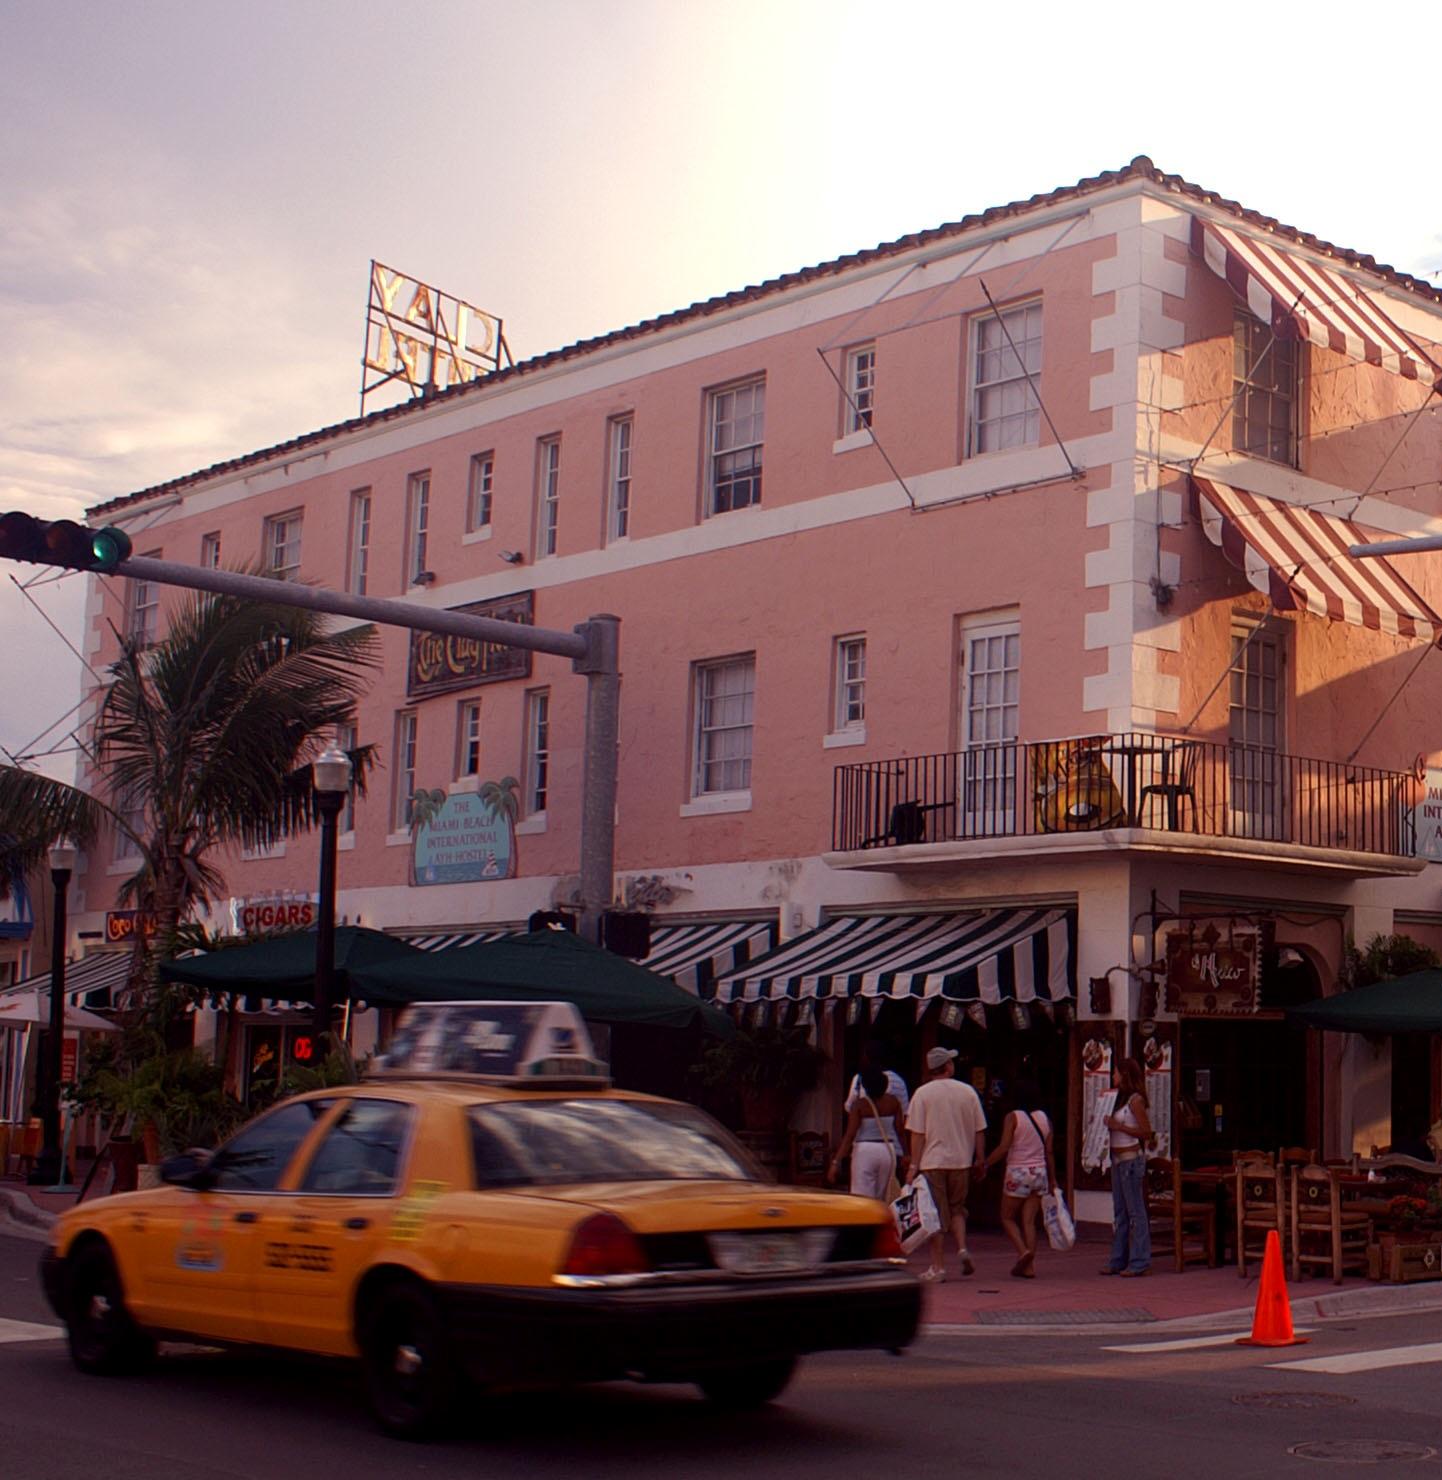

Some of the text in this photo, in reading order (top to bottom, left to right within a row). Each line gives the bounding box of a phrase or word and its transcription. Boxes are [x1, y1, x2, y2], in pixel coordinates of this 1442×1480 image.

[453, 801, 470, 813] THE
[427, 832, 496, 849] INTERNATIONAL
[243, 904, 312, 928] CIGARS
